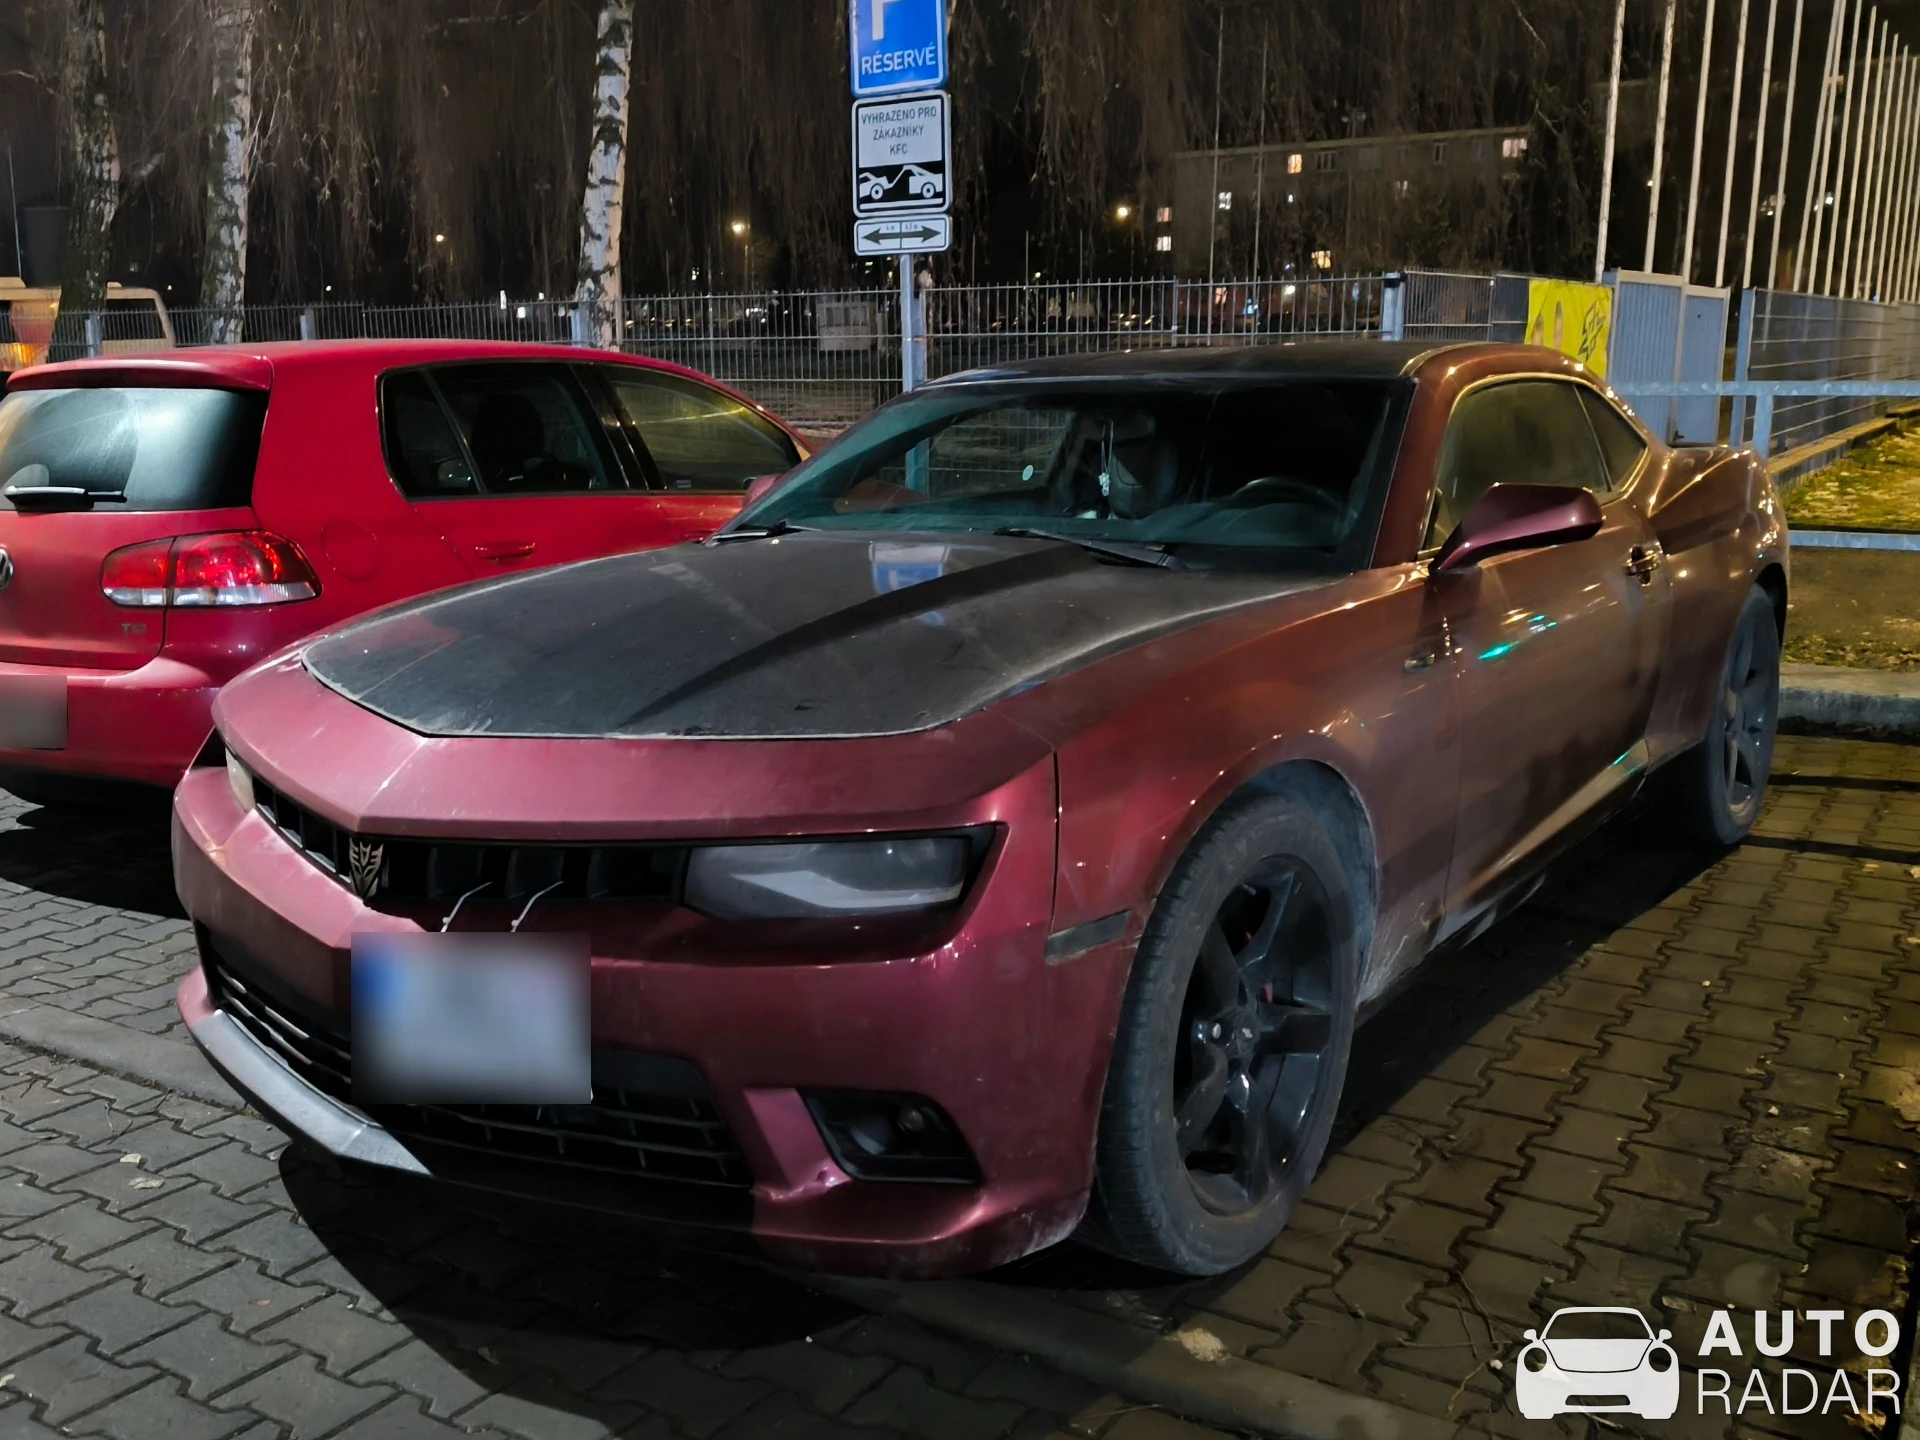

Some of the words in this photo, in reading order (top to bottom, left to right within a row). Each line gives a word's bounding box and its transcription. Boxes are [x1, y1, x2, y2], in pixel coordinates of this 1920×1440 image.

[861, 41, 937, 76] RÉSERVÉ
[861, 108, 916, 125] VYHRAZENO
[917, 106, 937, 119] PRO
[873, 123, 924, 141] ZÁKAZNÍKY
[889, 143, 908, 156] KFC
